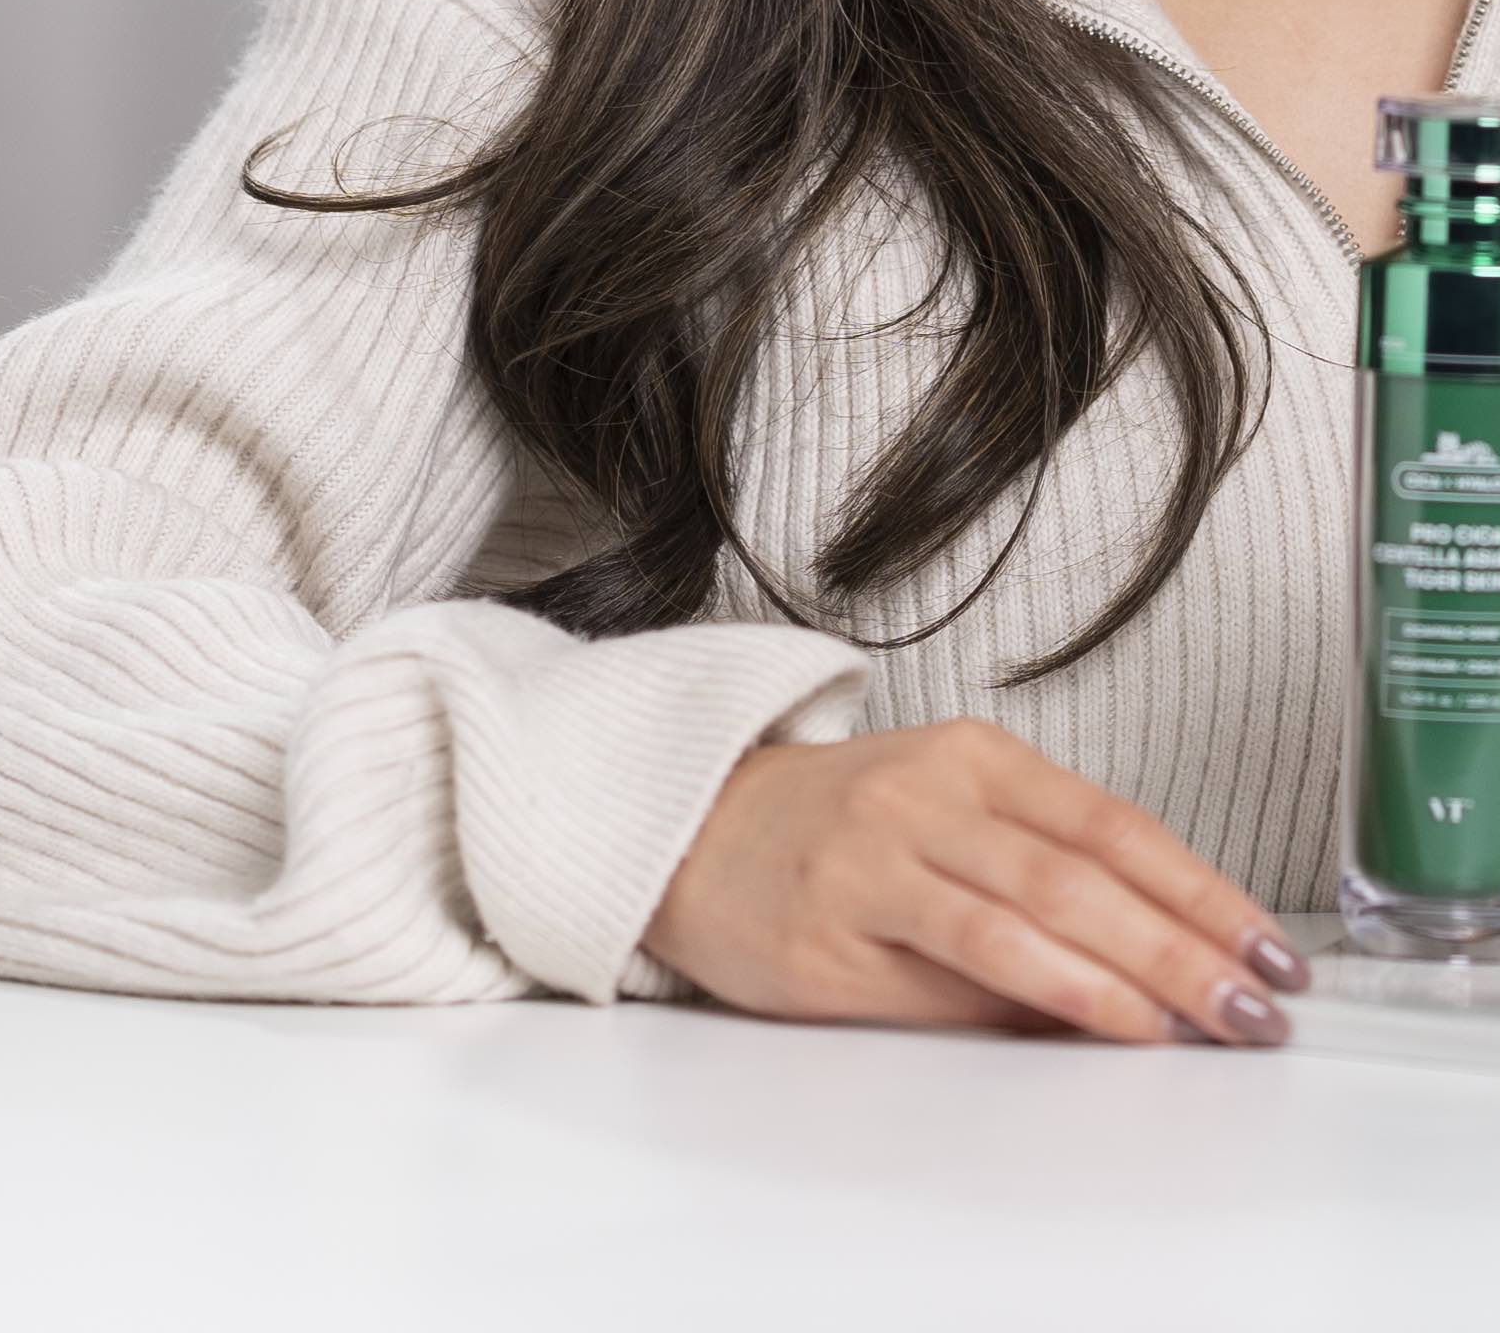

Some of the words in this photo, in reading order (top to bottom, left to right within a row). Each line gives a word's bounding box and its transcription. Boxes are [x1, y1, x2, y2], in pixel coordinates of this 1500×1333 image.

[1409, 521, 1452, 545] PRO
[1371, 541, 1461, 567] CENTELLA
[1403, 566, 1462, 591] TIGER
